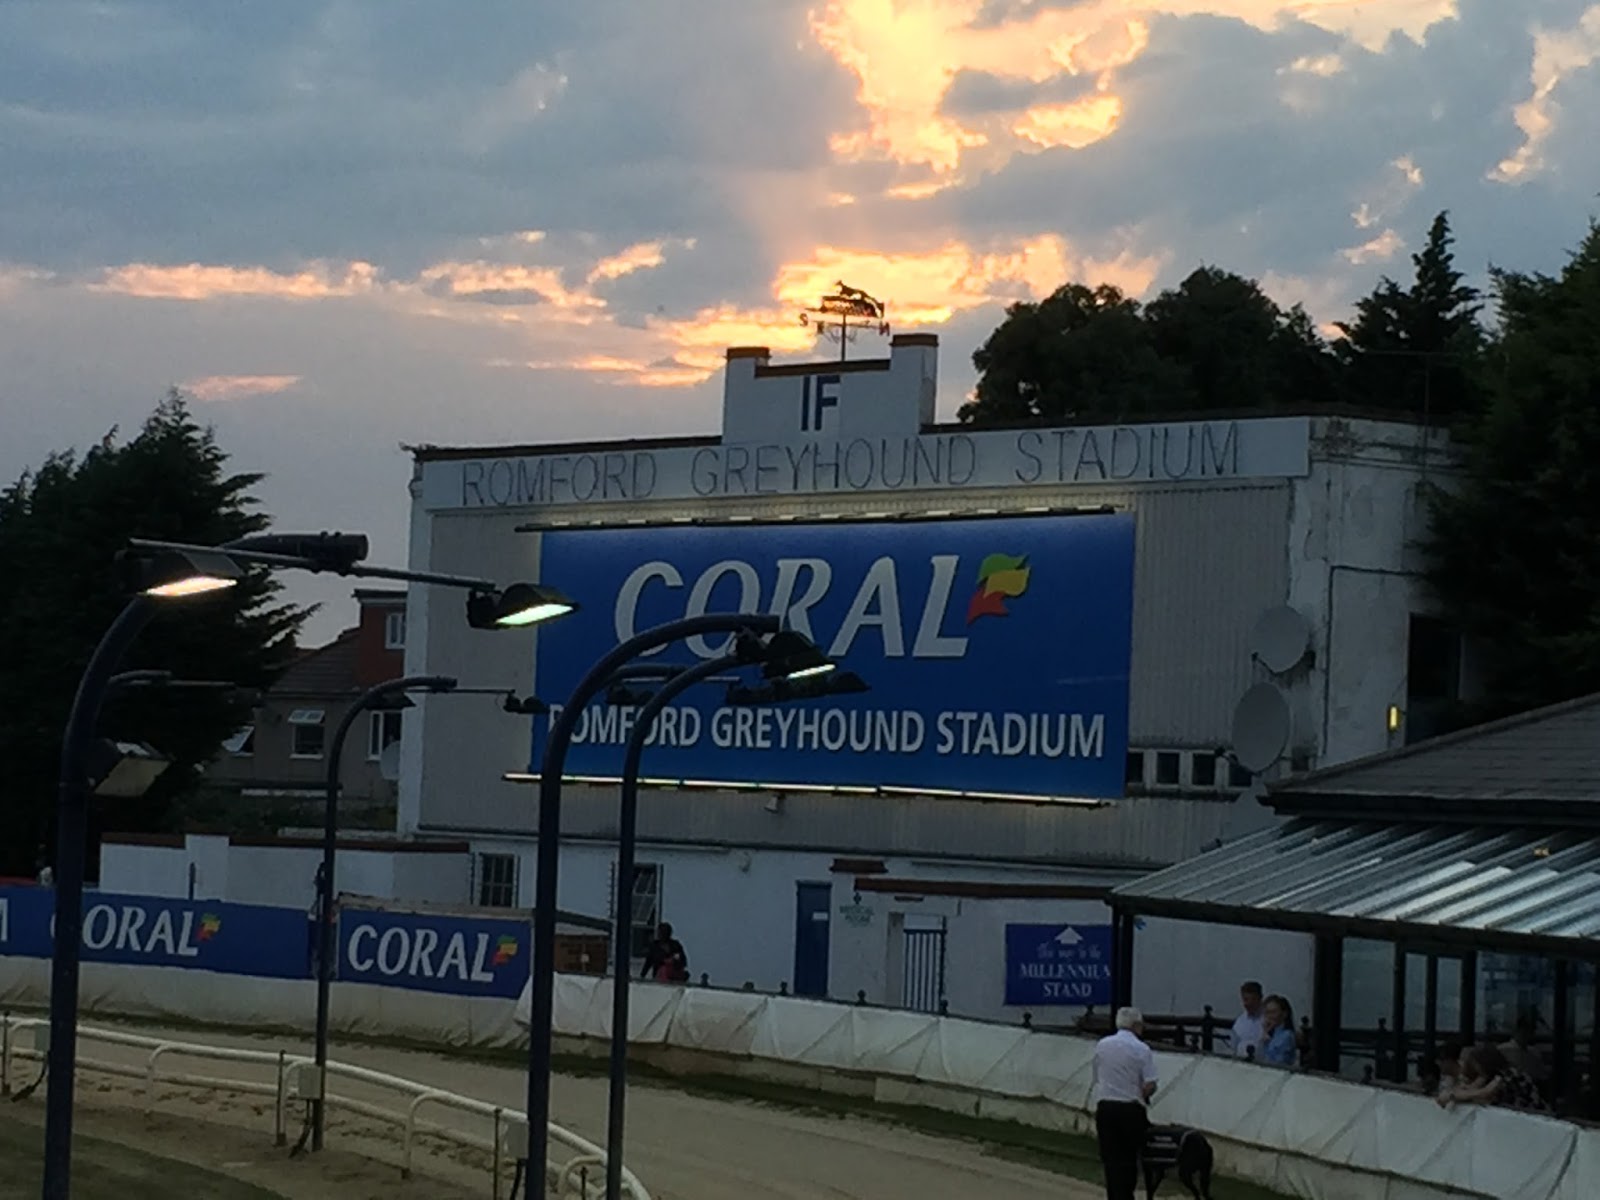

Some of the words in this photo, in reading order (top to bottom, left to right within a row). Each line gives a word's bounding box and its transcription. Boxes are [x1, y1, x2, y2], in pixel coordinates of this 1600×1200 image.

[801, 375, 841, 432] IF
[462, 452, 657, 506] ROMFORD
[691, 435, 976, 496] GREYHOUND
[1015, 421, 1238, 484] STADIUM
[614, 553, 969, 660] CORAL
[710, 706, 925, 754] GREYHOUND
[936, 710, 1106, 759] STADIUM
[51, 903, 200, 957] ORAL
[347, 924, 494, 983] CORAL
[1043, 981, 1093, 998] STAND
